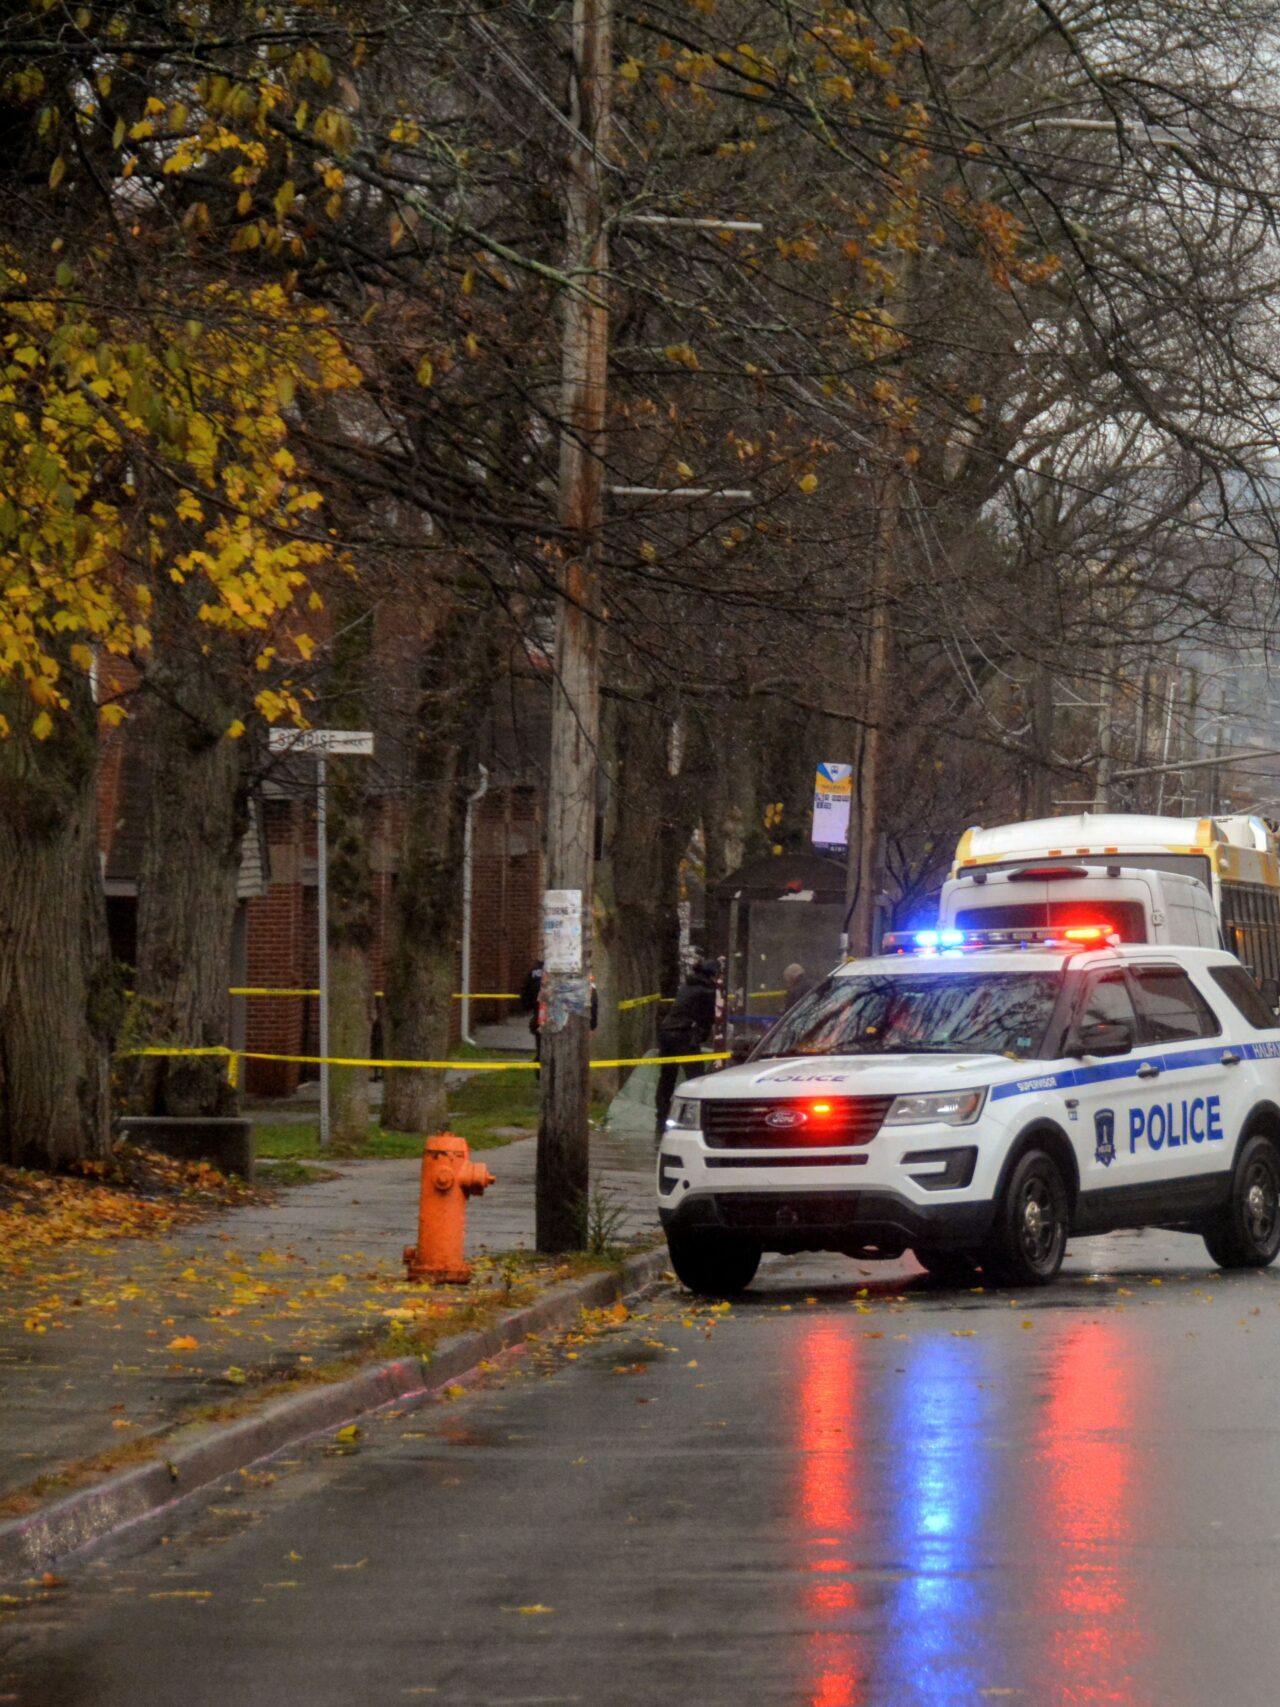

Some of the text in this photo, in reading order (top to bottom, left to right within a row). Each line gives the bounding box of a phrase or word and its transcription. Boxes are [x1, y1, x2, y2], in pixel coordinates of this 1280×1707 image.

[755, 1074, 849, 1084] POLICE
[1017, 1077, 1057, 1092] SUPERVISOR
[1129, 1095, 1223, 1154] POLICE
